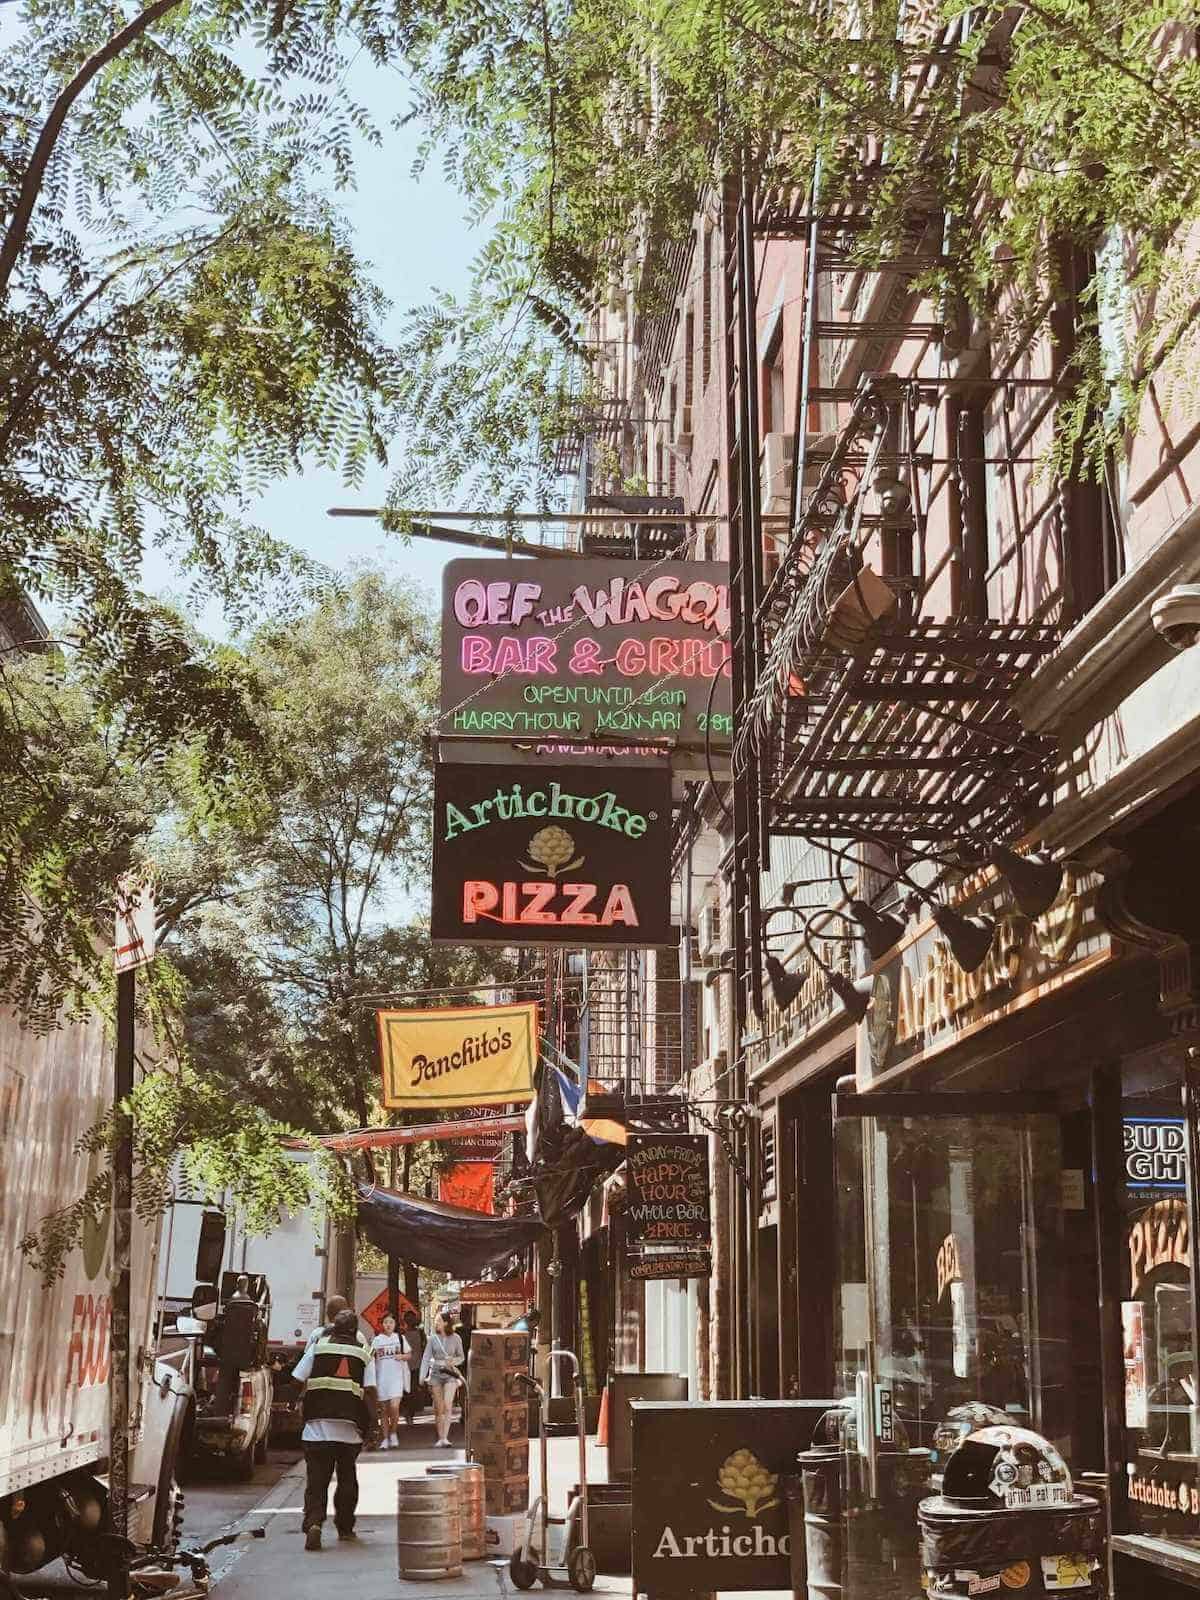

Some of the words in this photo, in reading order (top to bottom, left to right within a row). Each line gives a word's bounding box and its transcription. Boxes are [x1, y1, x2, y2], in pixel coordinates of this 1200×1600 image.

[454, 579, 542, 628] OFF
[537, 604, 574, 627] THE
[461, 635, 558, 675] BAR
[569, 636, 605, 675] &
[524, 685, 576, 703] OPEN
[524, 711, 581, 730] HOUR
[444, 782, 648, 841] Artichoke
[462, 881, 639, 927] PIZZA
[411, 1027, 512, 1087] Panchito's
[640, 1184, 690, 1203] HOUR
[657, 1222, 694, 1238] PRICE
[880, 1391, 893, 1441] PUSH
[1127, 1475, 1177, 1510] Artichoke
